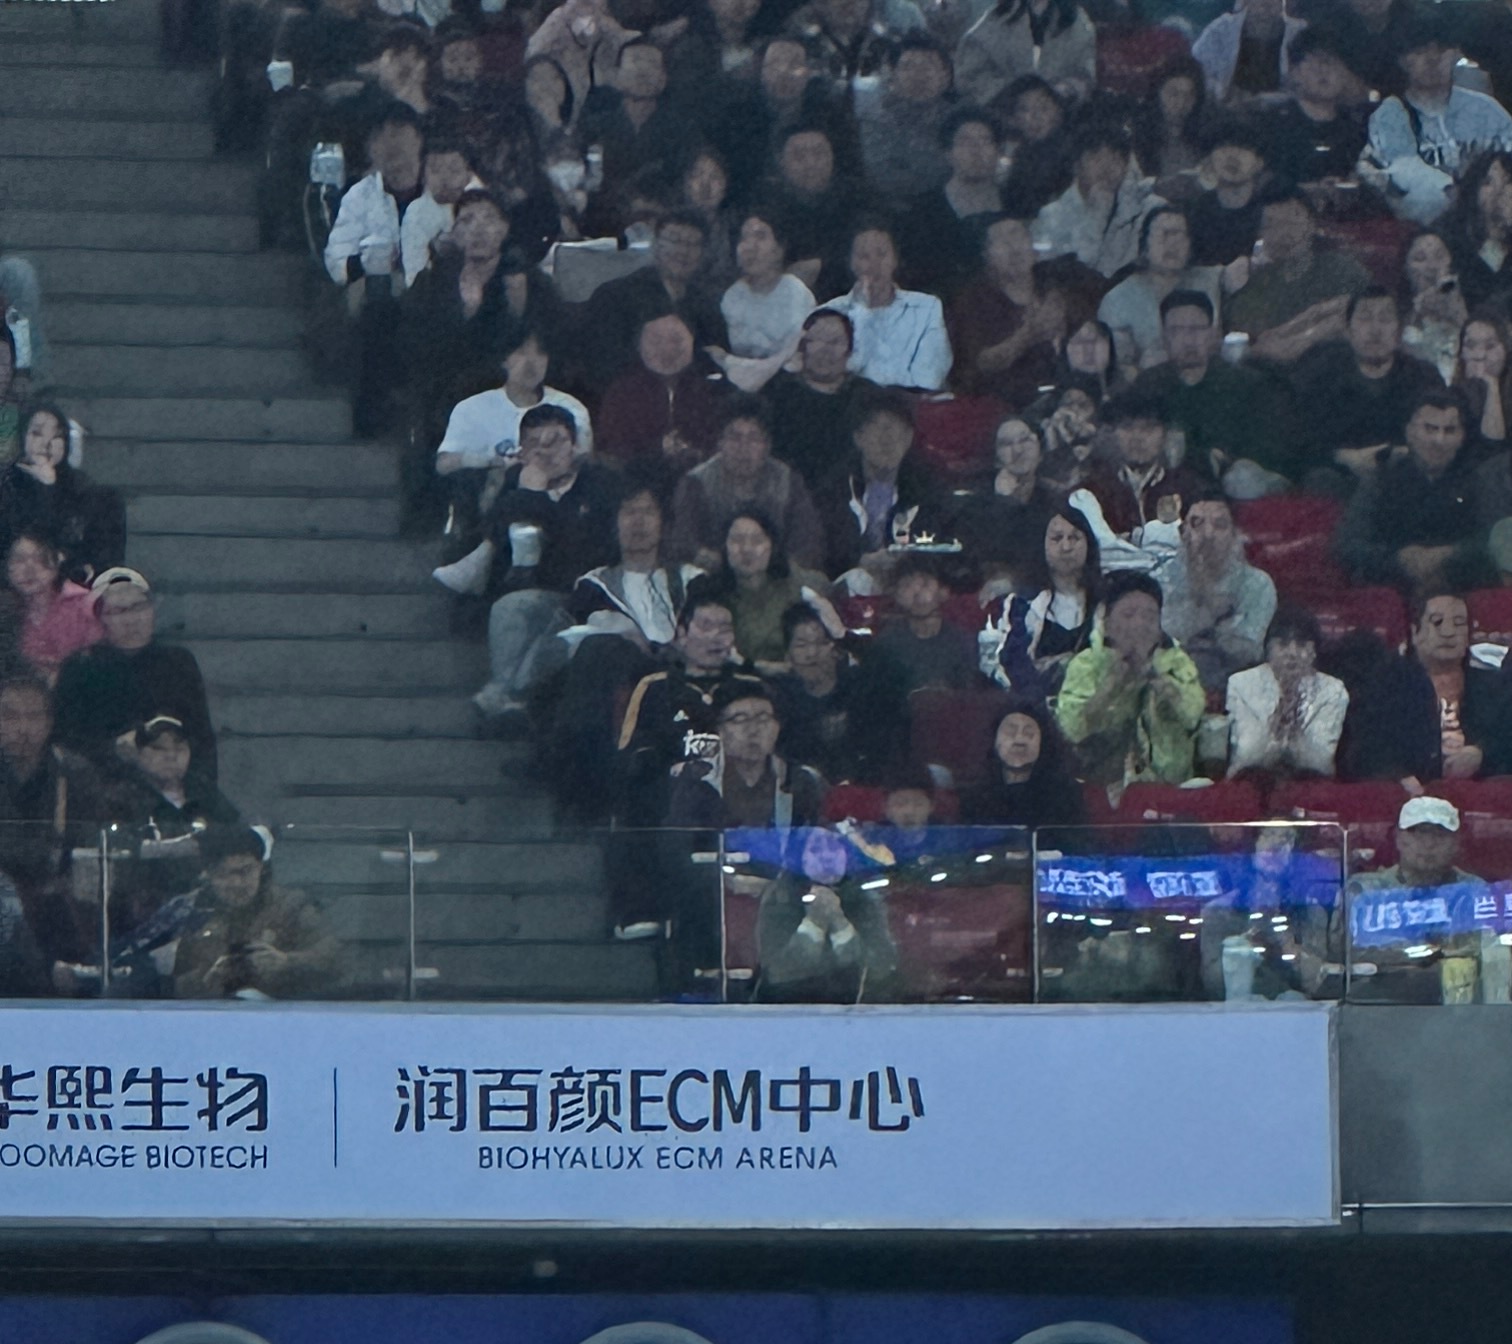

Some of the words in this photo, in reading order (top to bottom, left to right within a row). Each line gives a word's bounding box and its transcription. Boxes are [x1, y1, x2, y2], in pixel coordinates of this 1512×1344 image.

[394, 1065, 925, 1134] 润百颜ECM中心
[146, 1143, 268, 1169] BIOTECH
[477, 1145, 645, 1170] BIOHYALUX
[656, 1145, 724, 1170] ECM
[735, 1145, 838, 1170] ARENA
